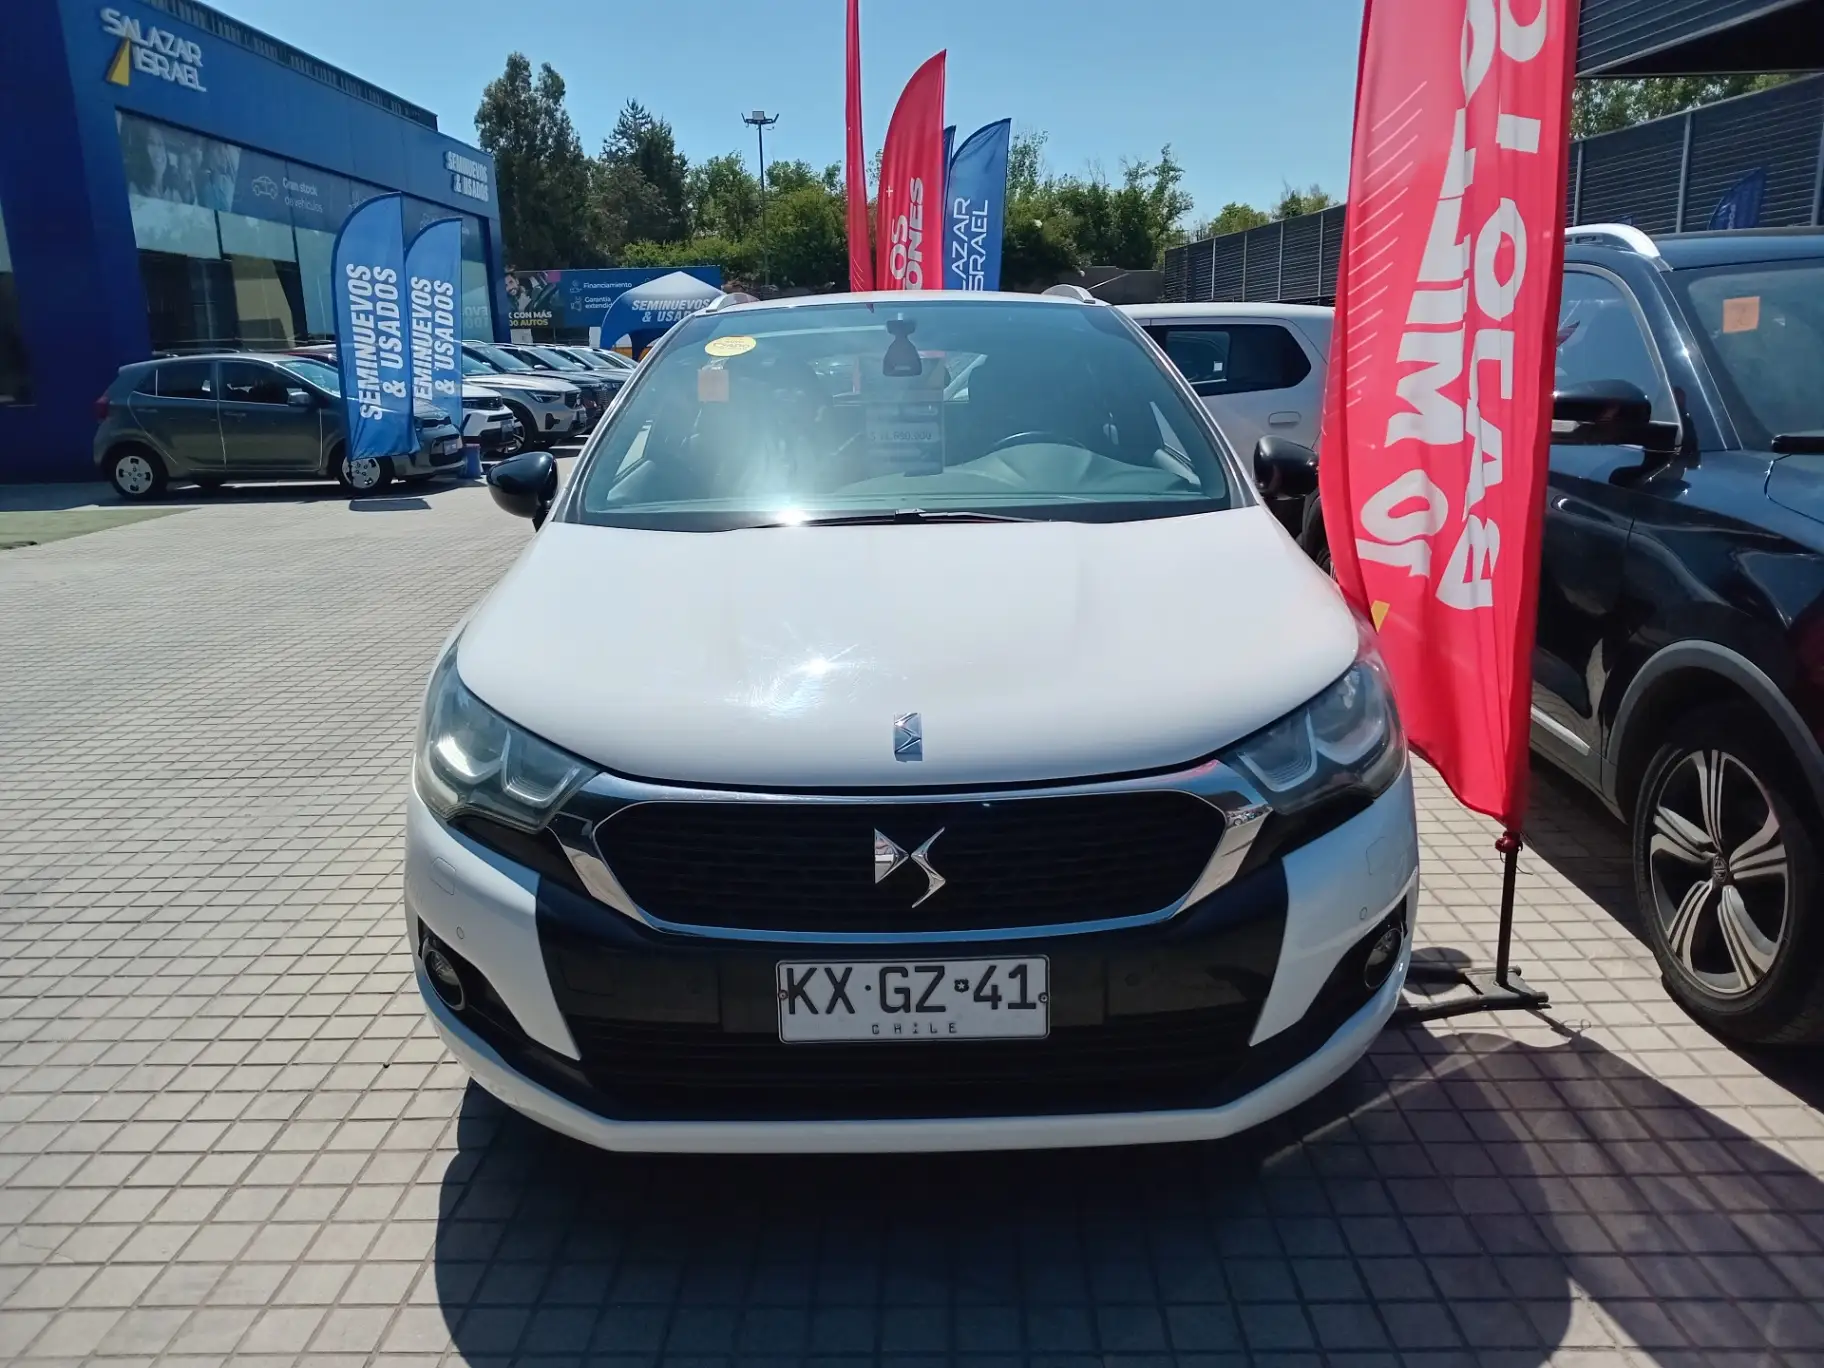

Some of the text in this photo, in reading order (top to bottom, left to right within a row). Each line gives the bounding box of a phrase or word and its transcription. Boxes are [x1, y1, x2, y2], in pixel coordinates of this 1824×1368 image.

[100, 7, 203, 67] SALAZAR
[132, 44, 208, 92] ISRAEL
[463, 176, 489, 202] USADOS
[889, 214, 908, 280] OS
[968, 199, 988, 291] SRAEL
[373, 266, 407, 398] & USADOS
[533, 310, 552, 318] MÁS
[631, 299, 711, 311] SEMINUEVOS
[642, 312, 652, 322] &
[345, 263, 383, 420] SEMINUEVOS
[410, 276, 433, 401] EMINUEVOS
[433, 280, 455, 395] & USADOS
[871, 1022, 958, 1035] CHILE
